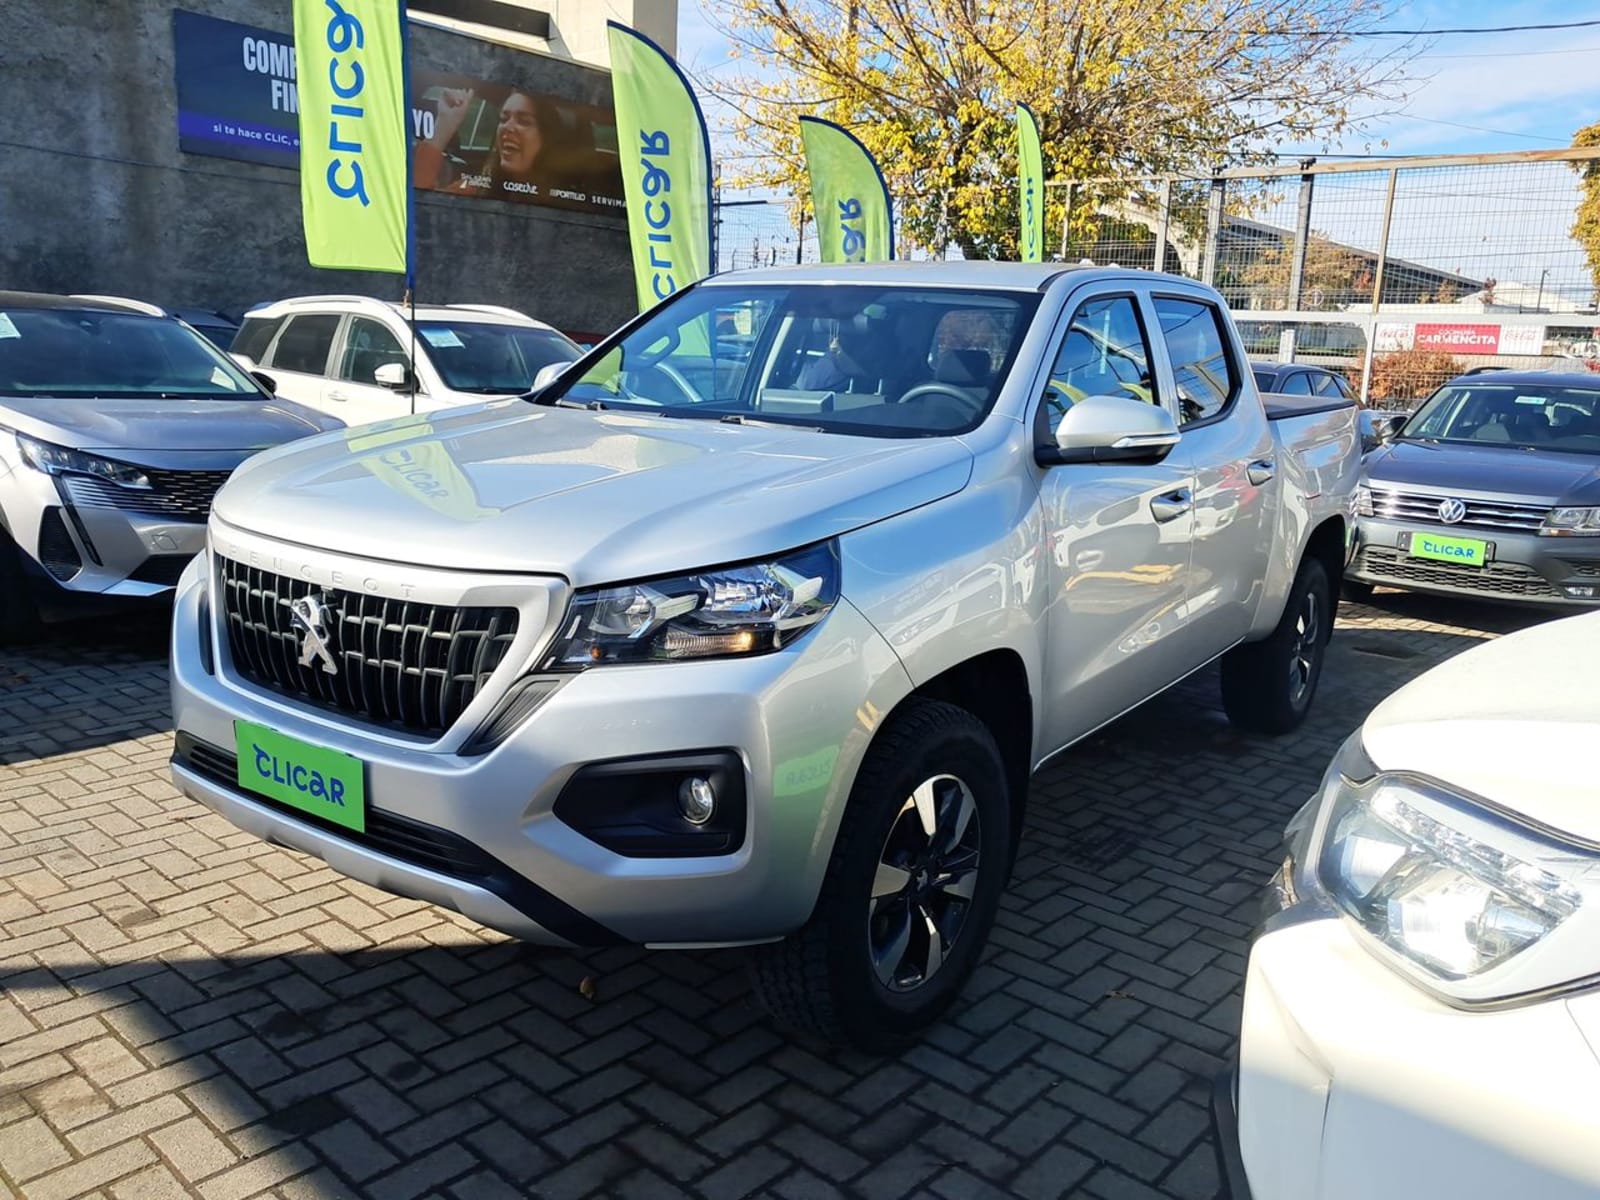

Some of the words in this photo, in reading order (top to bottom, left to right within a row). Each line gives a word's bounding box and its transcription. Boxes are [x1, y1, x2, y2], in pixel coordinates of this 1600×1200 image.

[213, 123, 222, 133] si
[224, 124, 236, 135] te
[238, 127, 262, 140] hace
[1417, 334, 1497, 345] CARMENCITA
[228, 544, 416, 598] PEUGEOT
